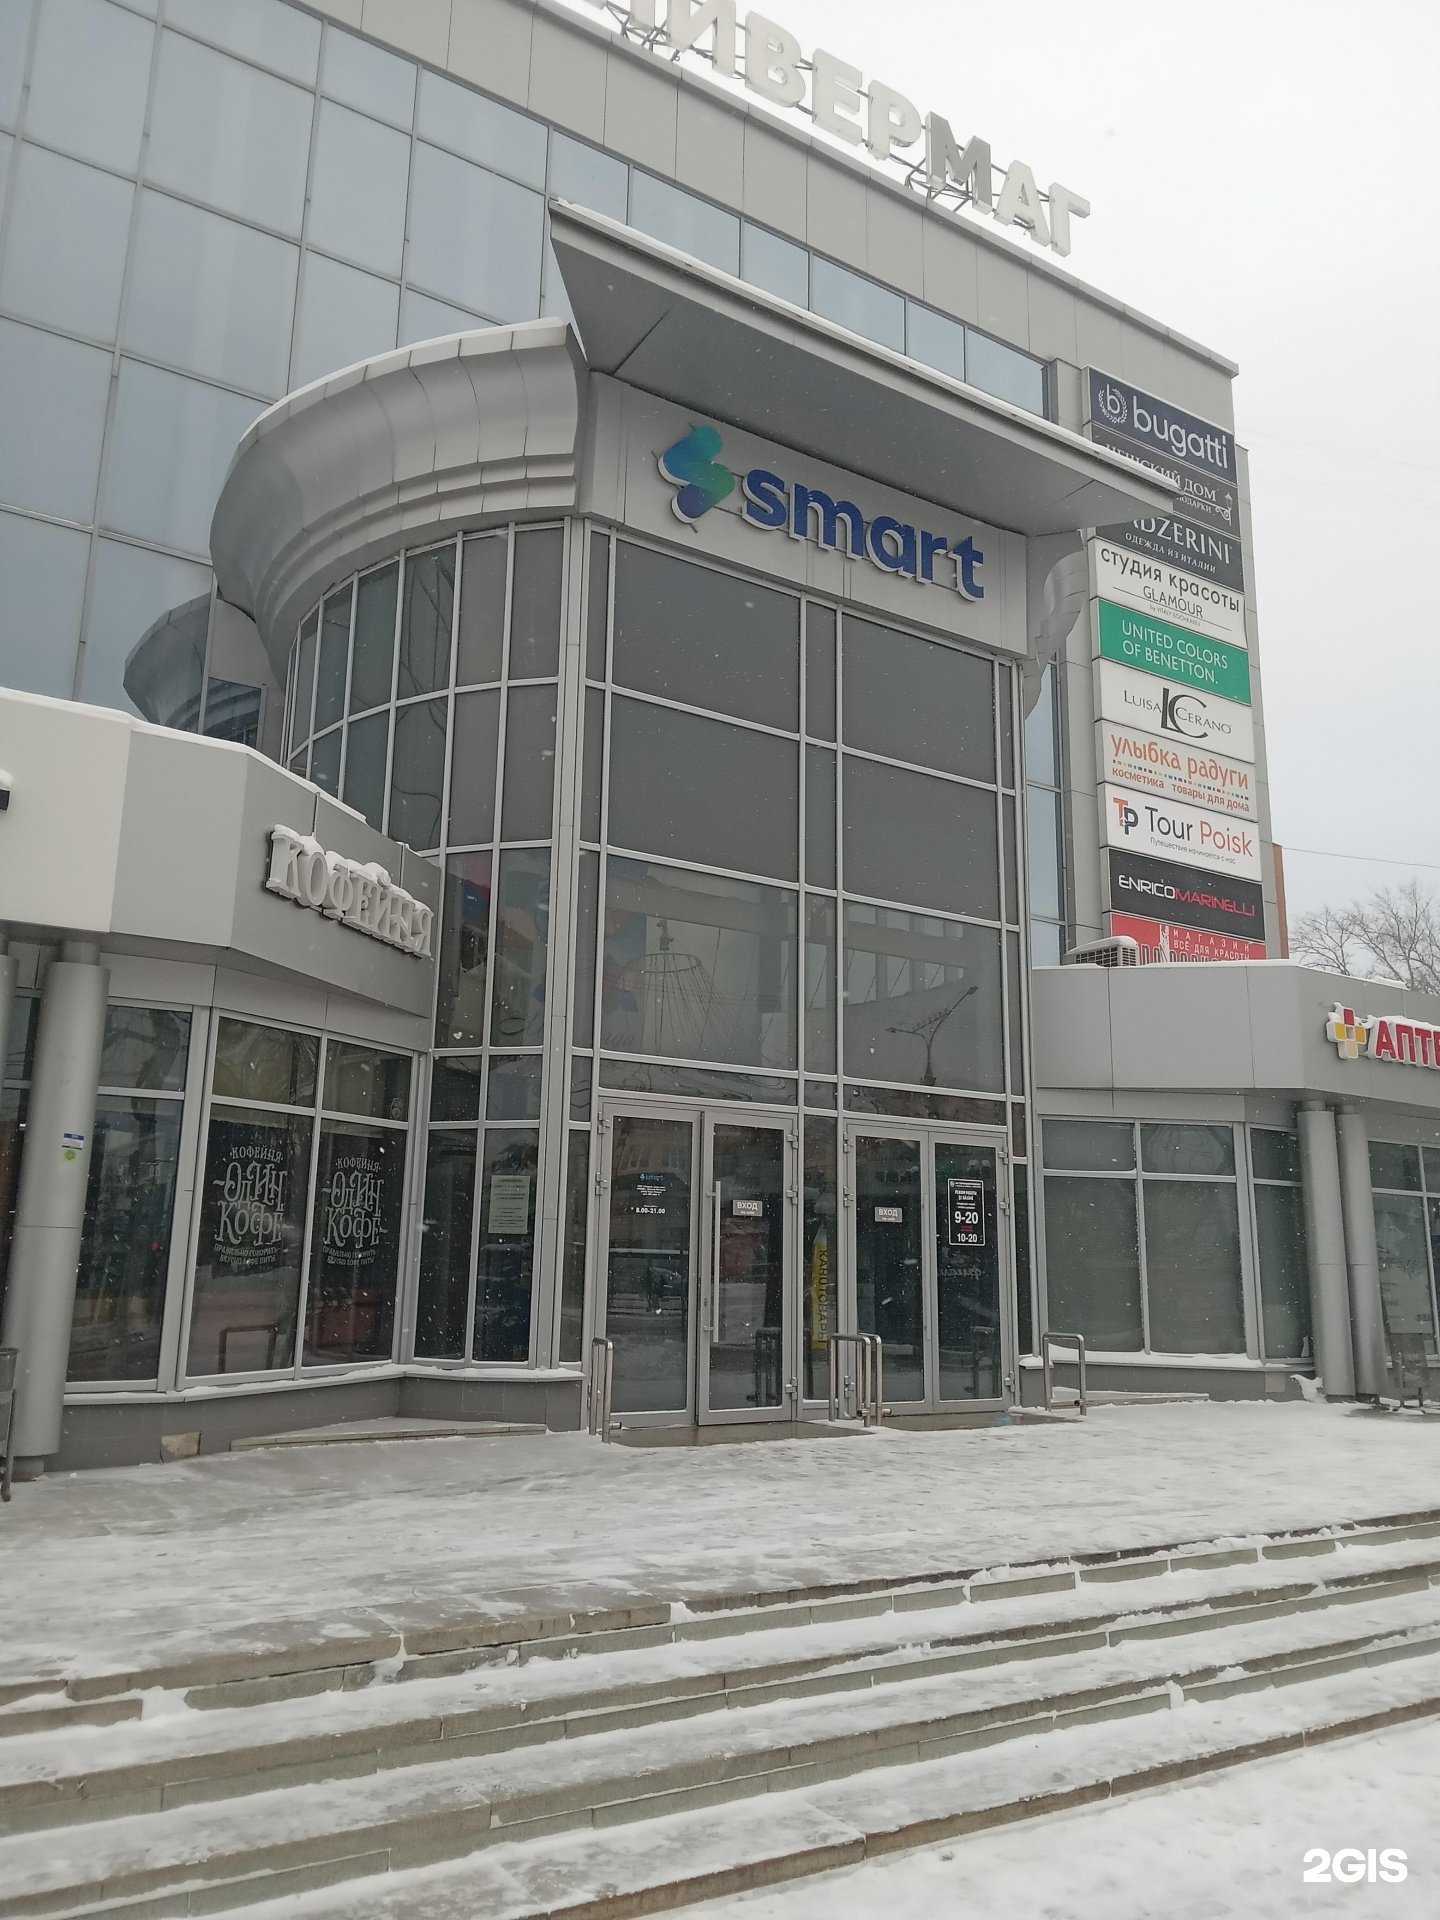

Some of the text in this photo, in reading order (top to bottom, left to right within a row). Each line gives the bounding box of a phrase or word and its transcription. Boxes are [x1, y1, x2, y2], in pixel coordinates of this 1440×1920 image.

[584, 0, 1090, 257] ИВЕРМАГ
[1132, 395, 1228, 469] bugatti
[1183, 478, 1217, 502] ДОМ
[742, 468, 985, 601] smart
[1125, 532, 1217, 574] ОДЕЖДА ИЗ ИТАЛИИ
[1143, 585, 1204, 619] GLAMOUR
[1169, 573, 1240, 613] красоты
[1122, 619, 1229, 669] UNITED COLORS
[1122, 640, 1142, 657] OF
[1124, 690, 1163, 714] LUISA
[1175, 707, 1232, 735] CERANO
[1111, 733, 1250, 790] улыбка радуги
[1112, 767, 1250, 813] косметика товары для дома
[1144, 805, 1253, 858] Tour Poisk
[1173, 928, 1250, 952] МАГАЗИН
[1194, 944, 1210, 956] ДЛЯ
[214, 1200, 284, 1247] КОФЕ
[737, 1201, 758, 1211] ВХОД
[878, 1208, 898, 1218] ВХОД
[954, 1211, 979, 1224] 9-20
[322, 1207, 381, 1249] КОФЕ
[956, 1233, 978, 1243] 10-20
